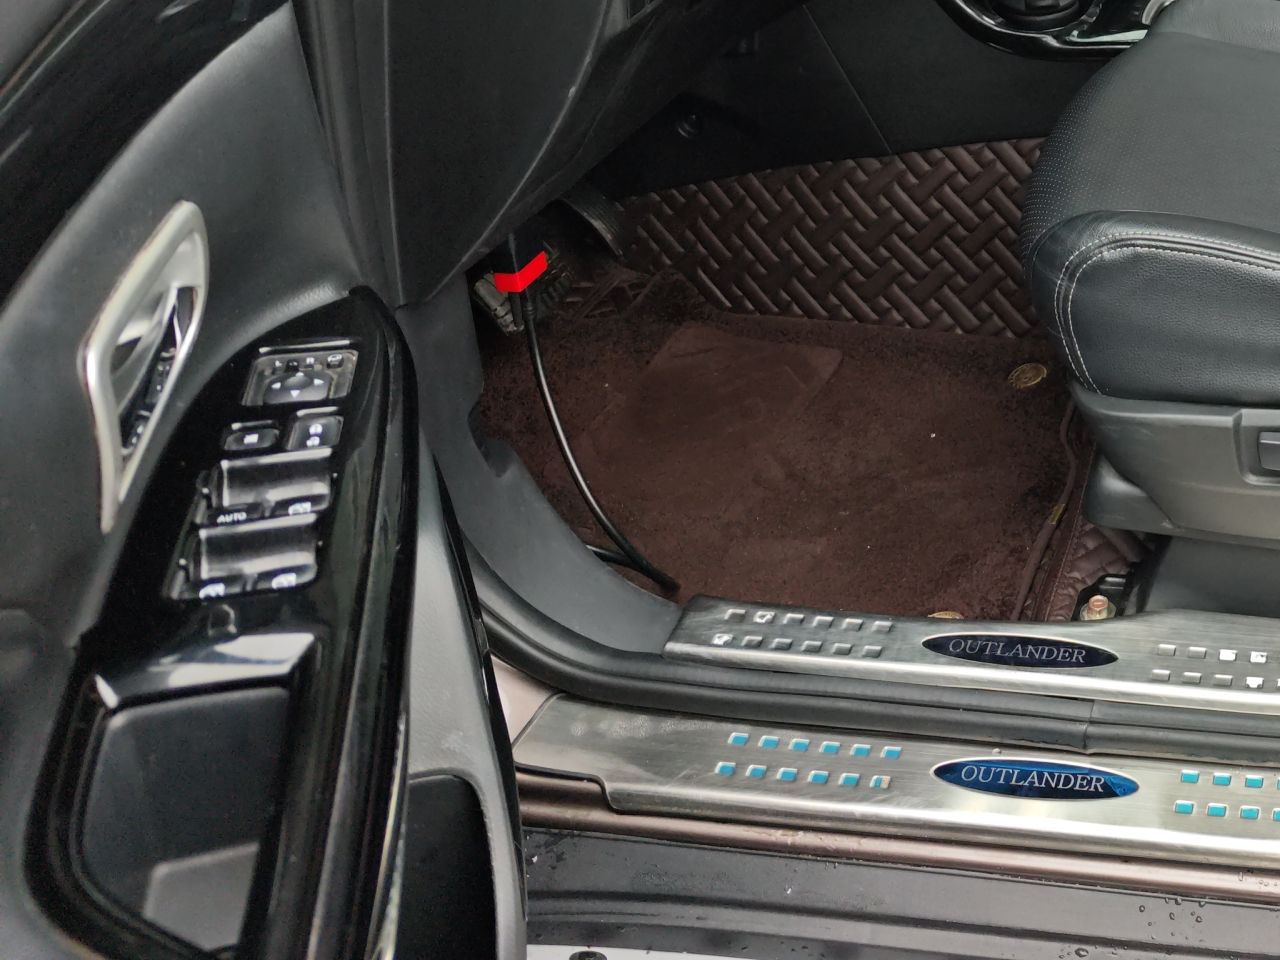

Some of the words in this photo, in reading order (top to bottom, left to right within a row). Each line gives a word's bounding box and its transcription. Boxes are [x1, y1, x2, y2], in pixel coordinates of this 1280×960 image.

[217, 511, 247, 523] AUTO
[949, 638, 1086, 663] OUTLANDER
[960, 765, 1105, 793] OUTLANDER
